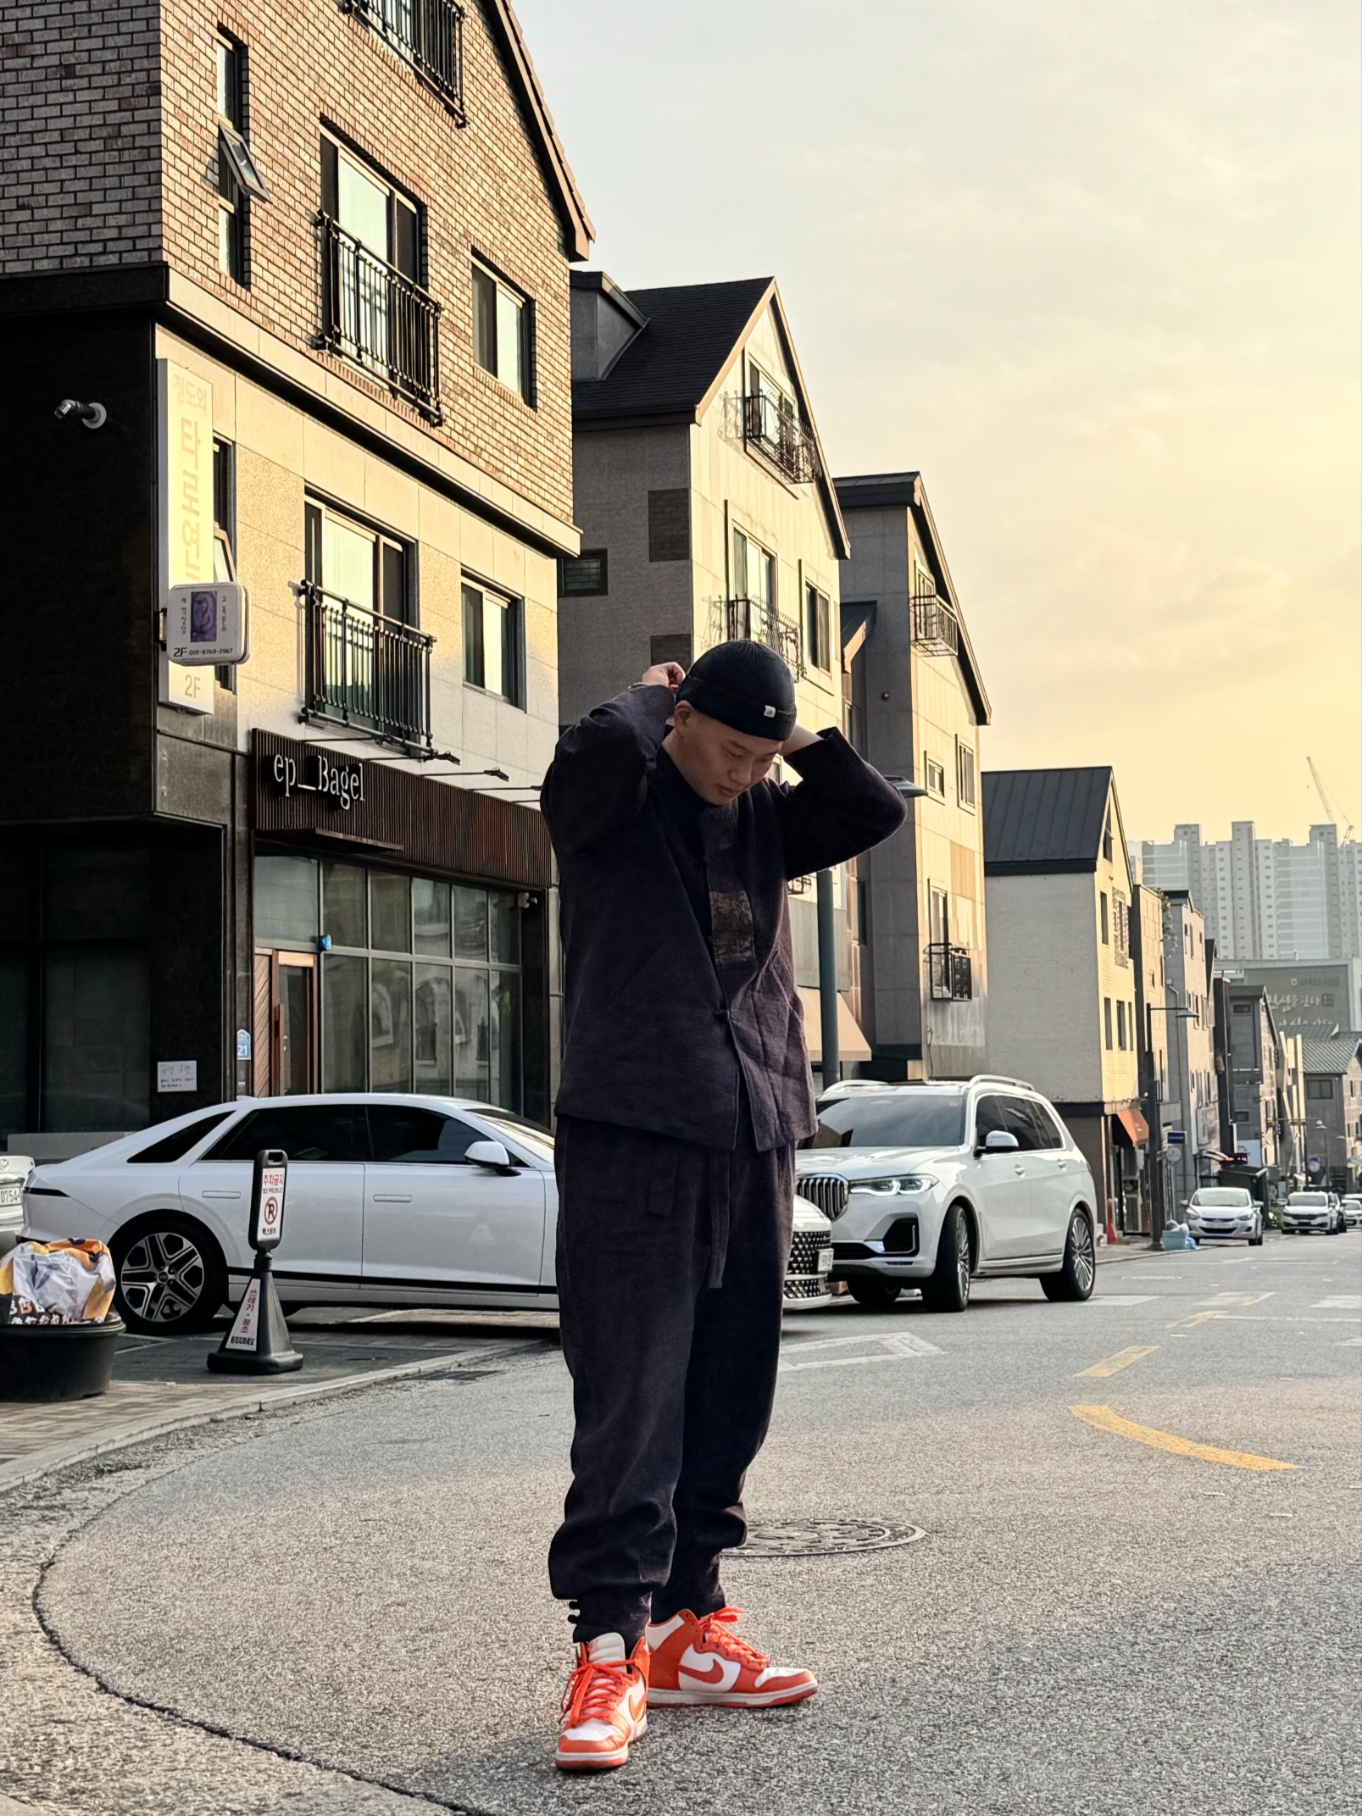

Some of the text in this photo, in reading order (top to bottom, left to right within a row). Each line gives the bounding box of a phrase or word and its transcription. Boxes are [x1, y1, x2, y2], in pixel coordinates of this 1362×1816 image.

[181, 416, 201, 583] 타로연
[173, 647, 188, 658] 2F
[184, 674, 201, 699] 2F
[237, 1044, 248, 1057] 21
